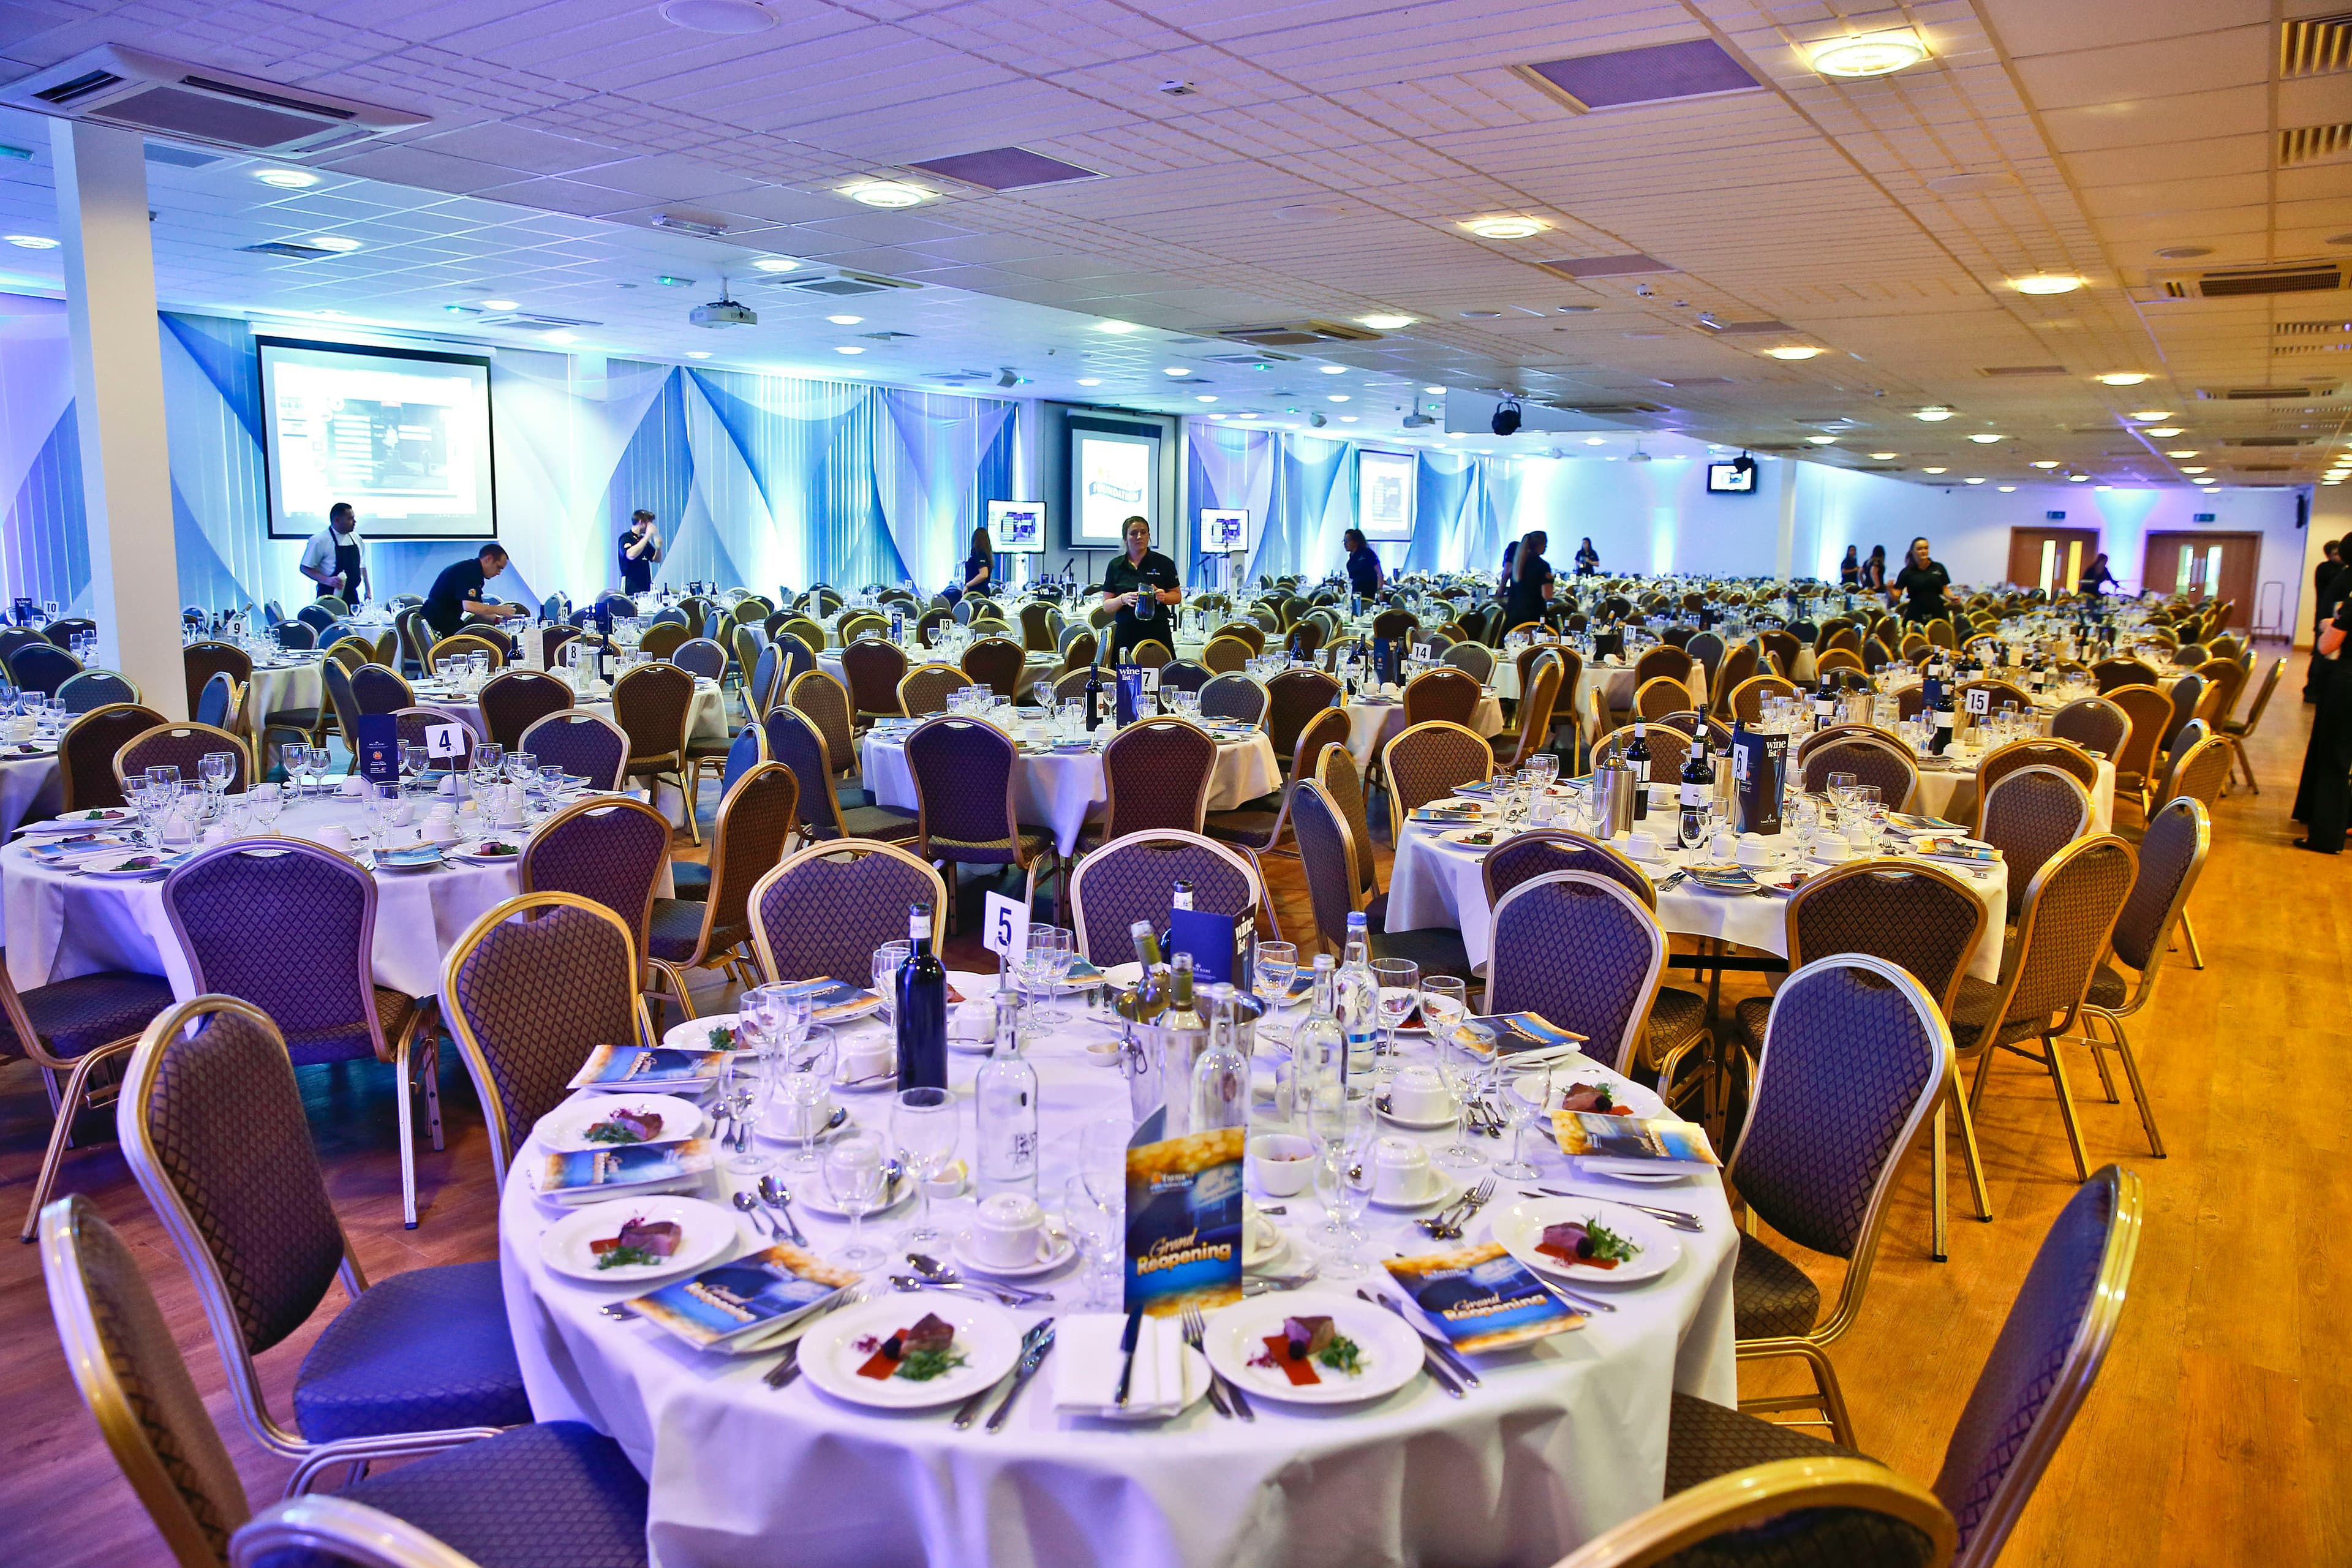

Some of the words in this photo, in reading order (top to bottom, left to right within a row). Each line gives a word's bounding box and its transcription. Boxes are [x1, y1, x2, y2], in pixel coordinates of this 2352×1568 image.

[1093, 482, 1138, 502] FOUNDATION
[47, 603, 56, 612] 10
[561, 609, 567, 618] 12
[234, 622, 240, 633] 9
[943, 620, 950, 630] 13
[1627, 627, 1634, 637] 17
[571, 646, 576, 658] 8
[1415, 646, 1427, 658] 14
[1119, 666, 1140, 675] wine
[1143, 671, 1151, 687] 7
[1971, 693, 1985, 710] 15
[439, 729, 452, 752] 4
[1766, 738, 1787, 750] wine
[1768, 748, 1777, 758] list
[1736, 750, 1743, 773] 6
[998, 907, 1012, 946] 5
[1235, 916, 1254, 940] wine
[1148, 1227, 1198, 1257] Grand
[1136, 1242, 1232, 1276] Reopening
